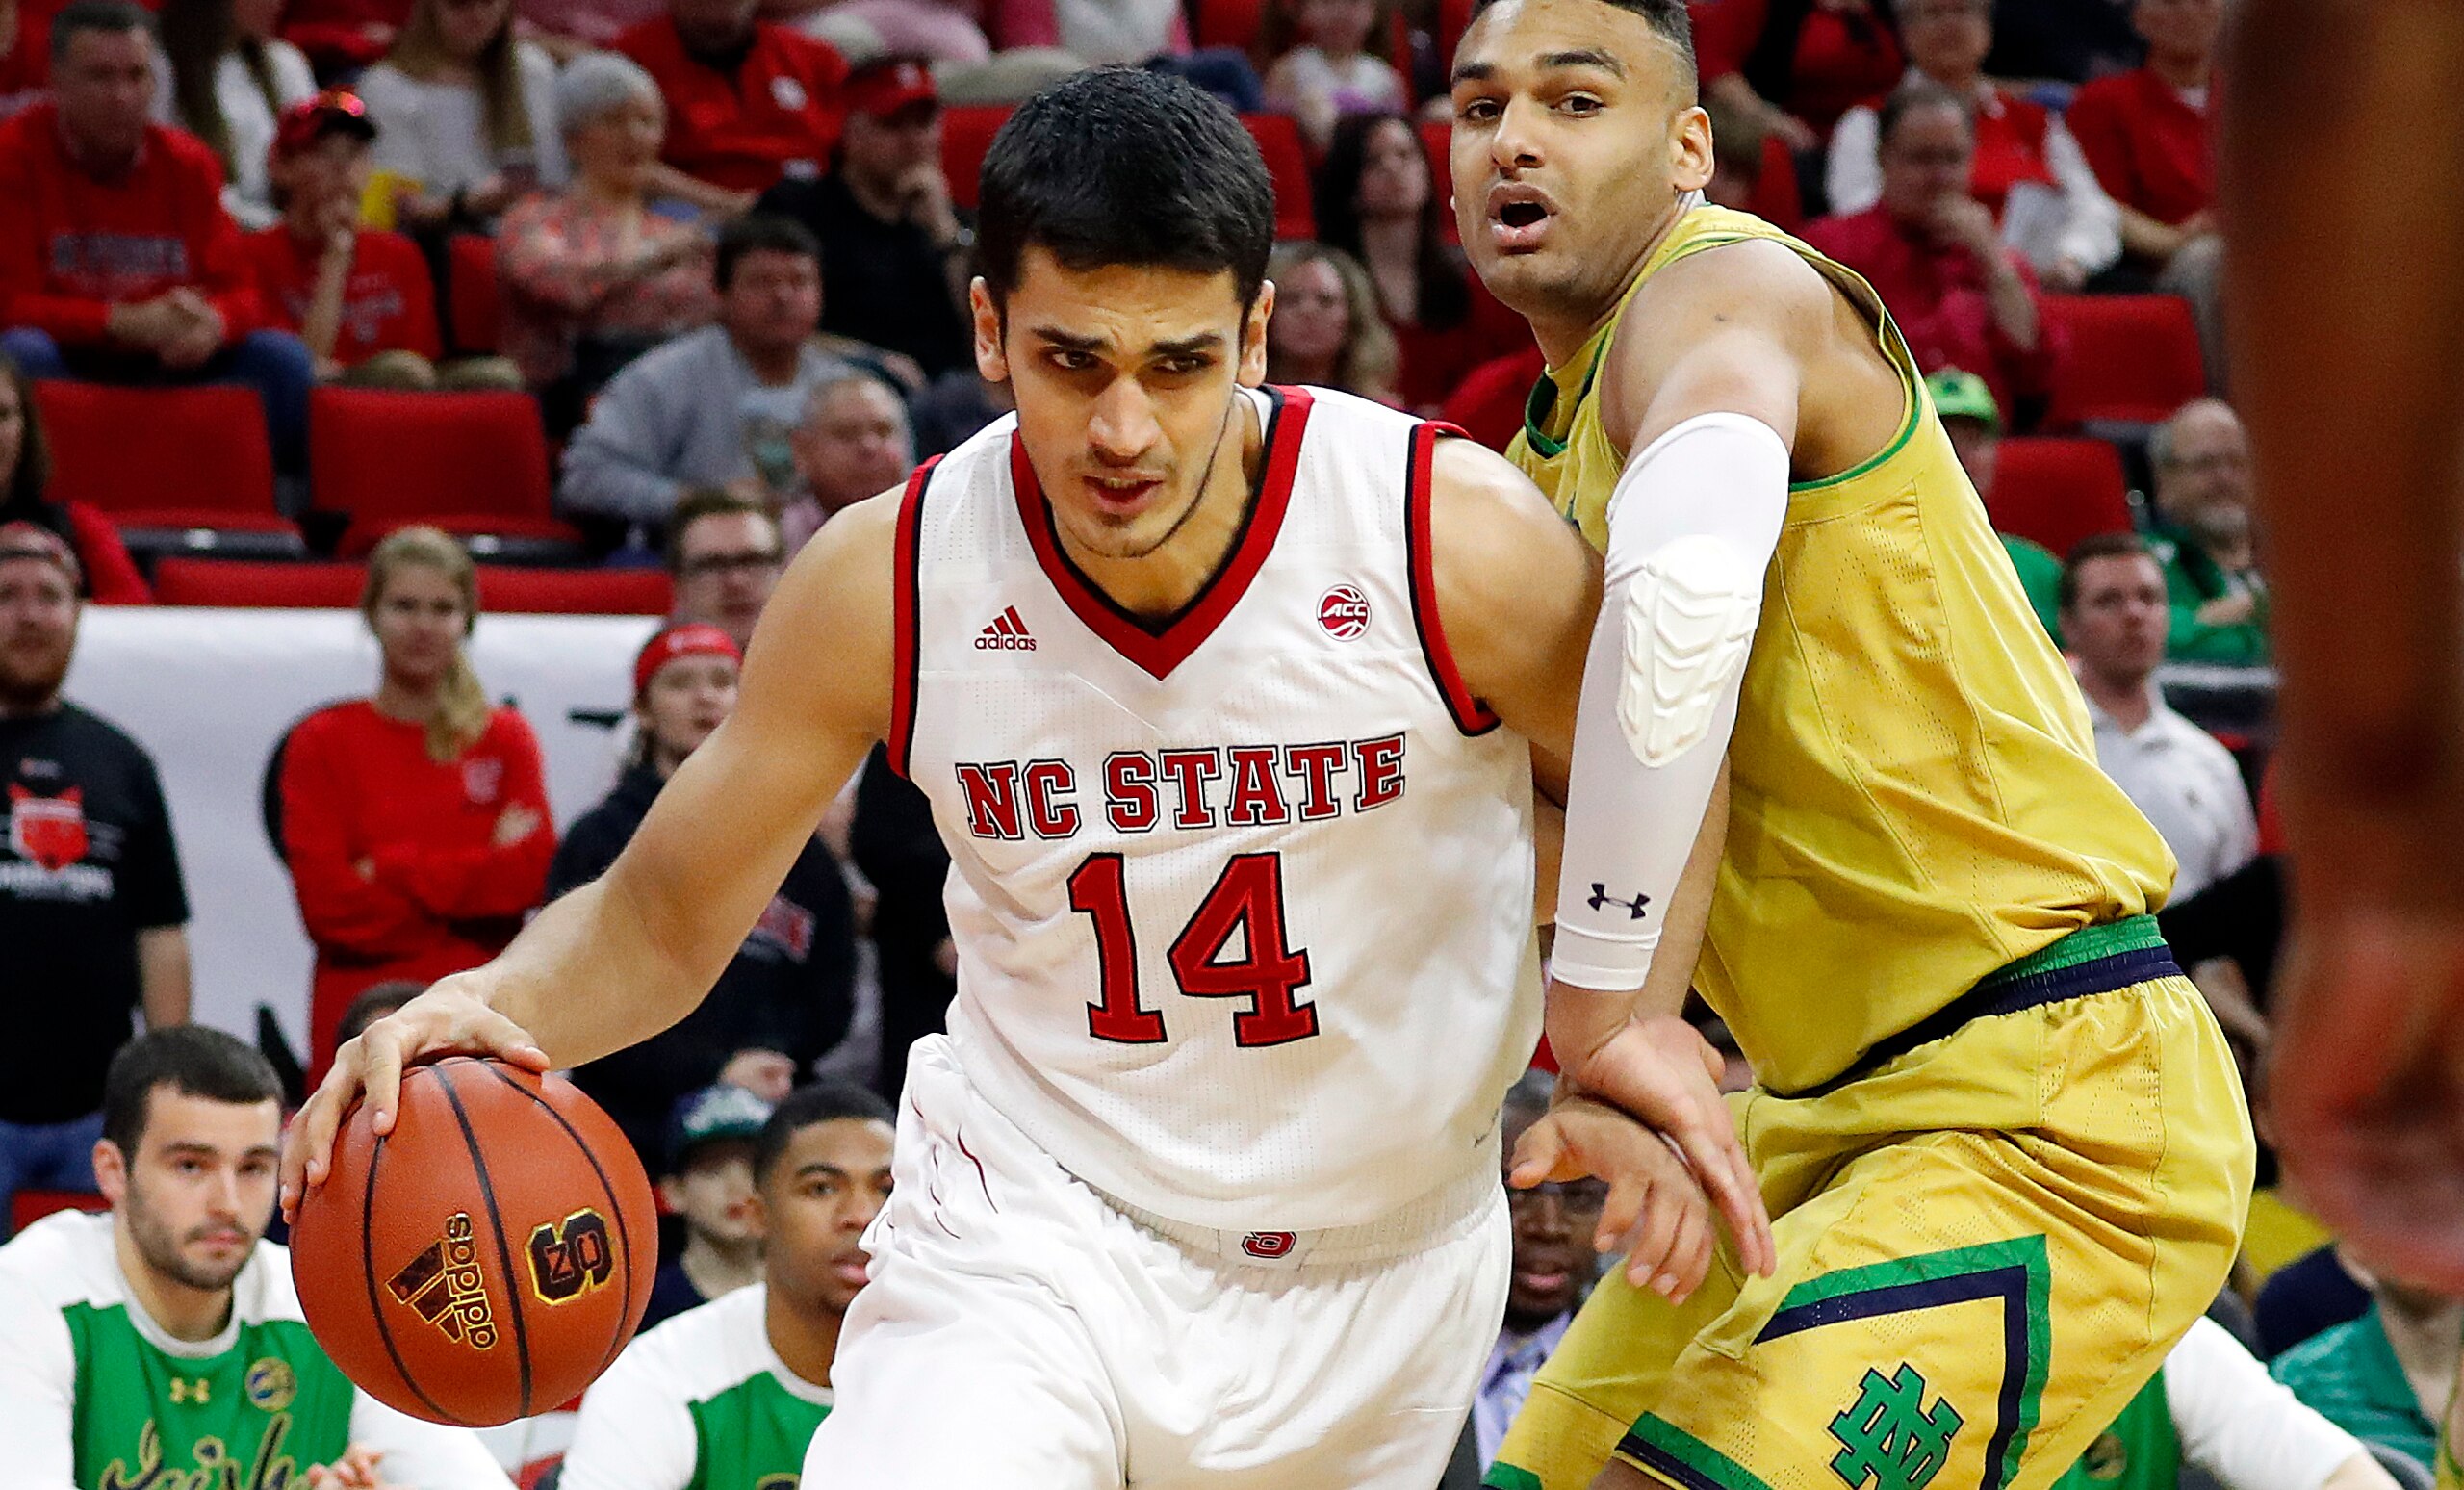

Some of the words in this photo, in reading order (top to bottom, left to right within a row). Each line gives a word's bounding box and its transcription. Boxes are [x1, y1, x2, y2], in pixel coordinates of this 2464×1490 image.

[974, 633, 1037, 652] adidas
[1322, 603, 1369, 618] ACC
[955, 758, 1083, 841] NC
[1102, 732, 1406, 834] STATE
[1066, 851, 1320, 1048] 14
[445, 1209, 499, 1350] adidas
